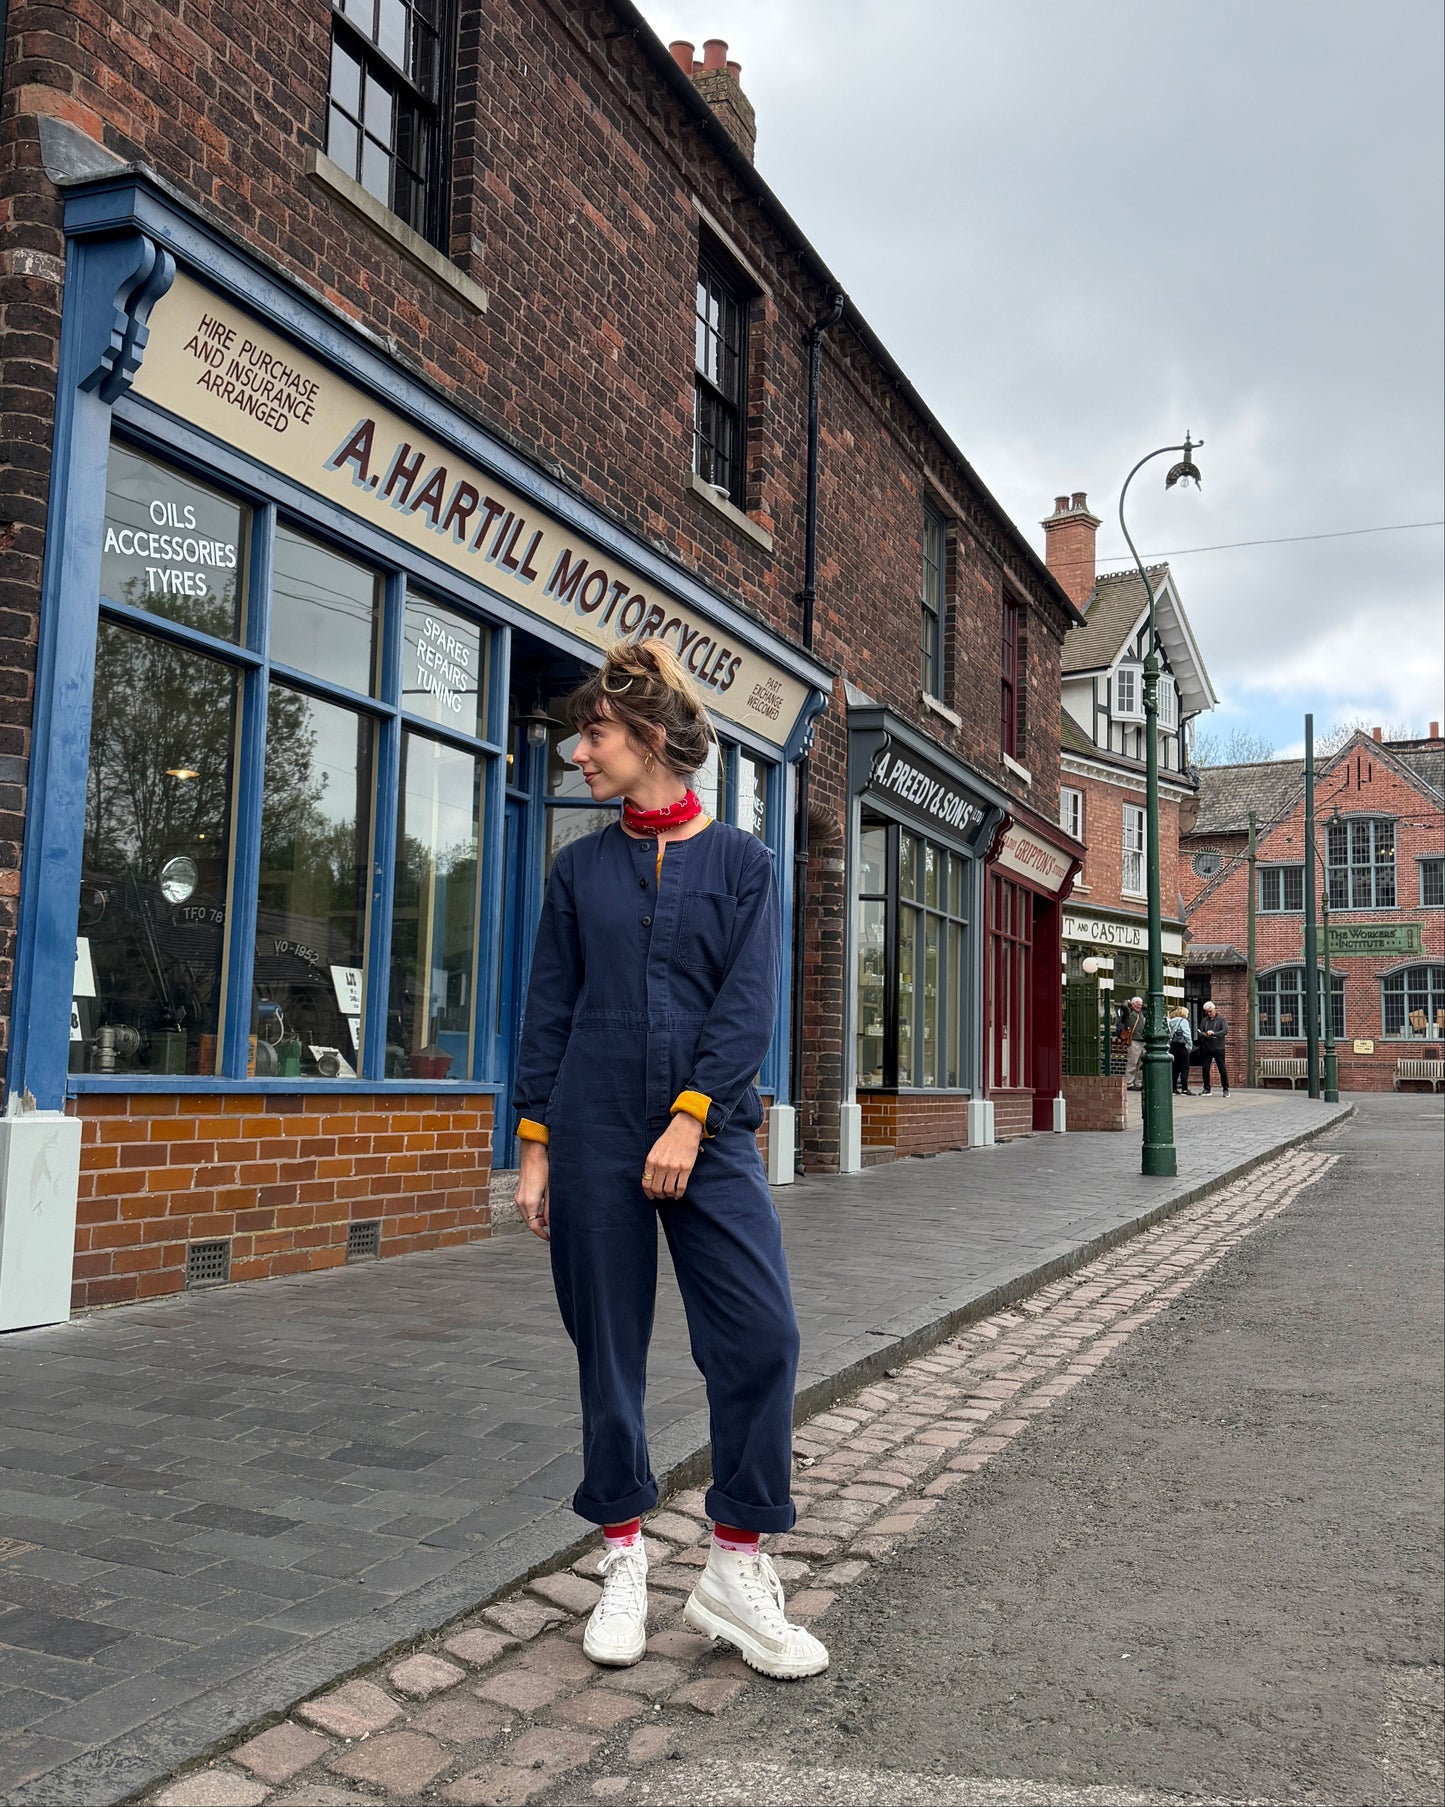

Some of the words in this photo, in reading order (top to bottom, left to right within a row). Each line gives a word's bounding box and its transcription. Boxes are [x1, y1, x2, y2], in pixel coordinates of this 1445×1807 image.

[198, 314, 237, 350] HIRE
[238, 340, 320, 402] PURCHASE
[183, 335, 224, 369] AND
[226, 357, 315, 425] INSURANCE
[196, 370, 289, 434] ARRANGED
[149, 500, 196, 530] OILS
[103, 528, 237, 569] ACCESSORIES
[145, 567, 207, 596] TYRES
[423, 617, 470, 667] SPARES
[417, 638, 468, 692] REPAIRS
[765, 677, 782, 693] PART
[417, 664, 462, 714] TUNING
[746, 694, 780, 721] WELCOMED
[752, 683, 784, 709] EXCHANGE
[1077, 923, 1089, 933] AND
[1091, 921, 1141, 946] CASTLE
